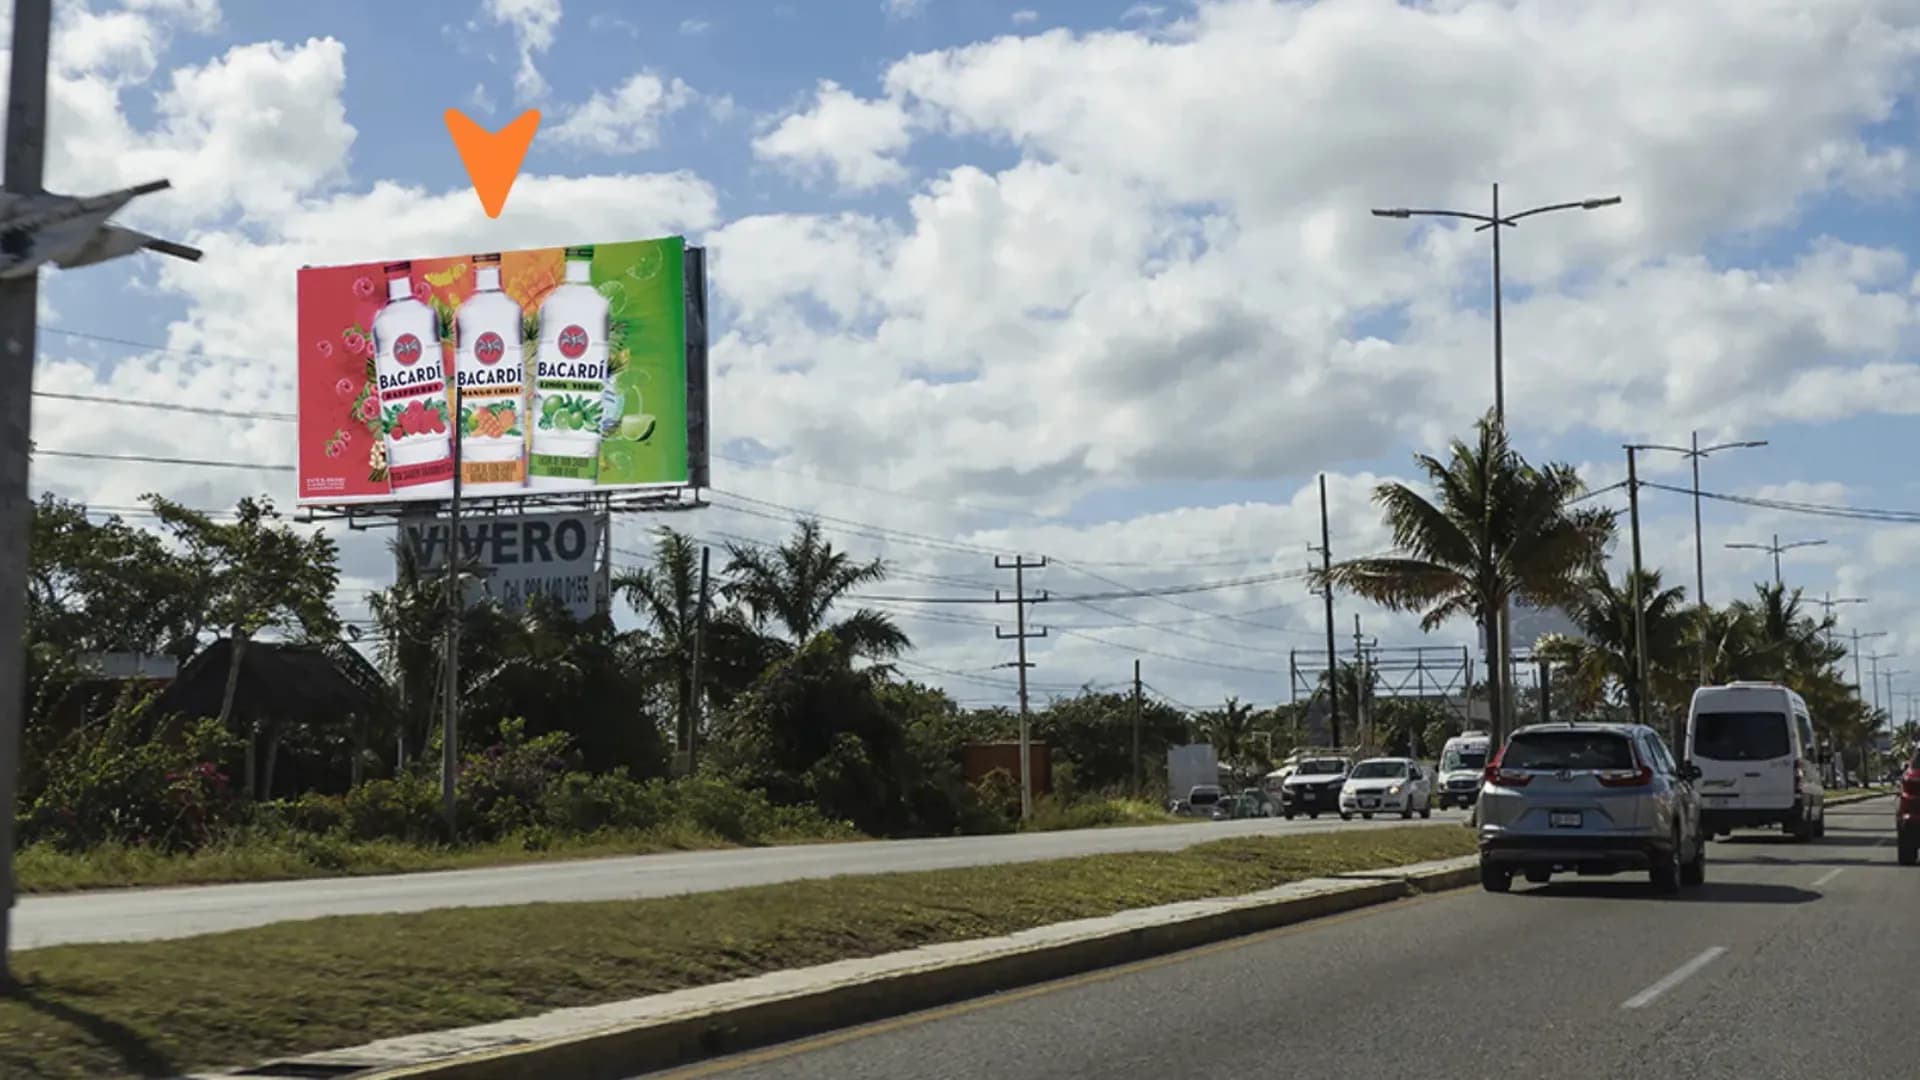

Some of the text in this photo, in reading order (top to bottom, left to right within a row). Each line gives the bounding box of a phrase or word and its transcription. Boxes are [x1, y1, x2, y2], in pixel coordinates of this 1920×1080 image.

[379, 360, 442, 390] BACARDÍ
[457, 363, 522, 386] BACARDÍ
[538, 360, 605, 379] BACARDÍ
[406, 518, 587, 567] VIVERO
